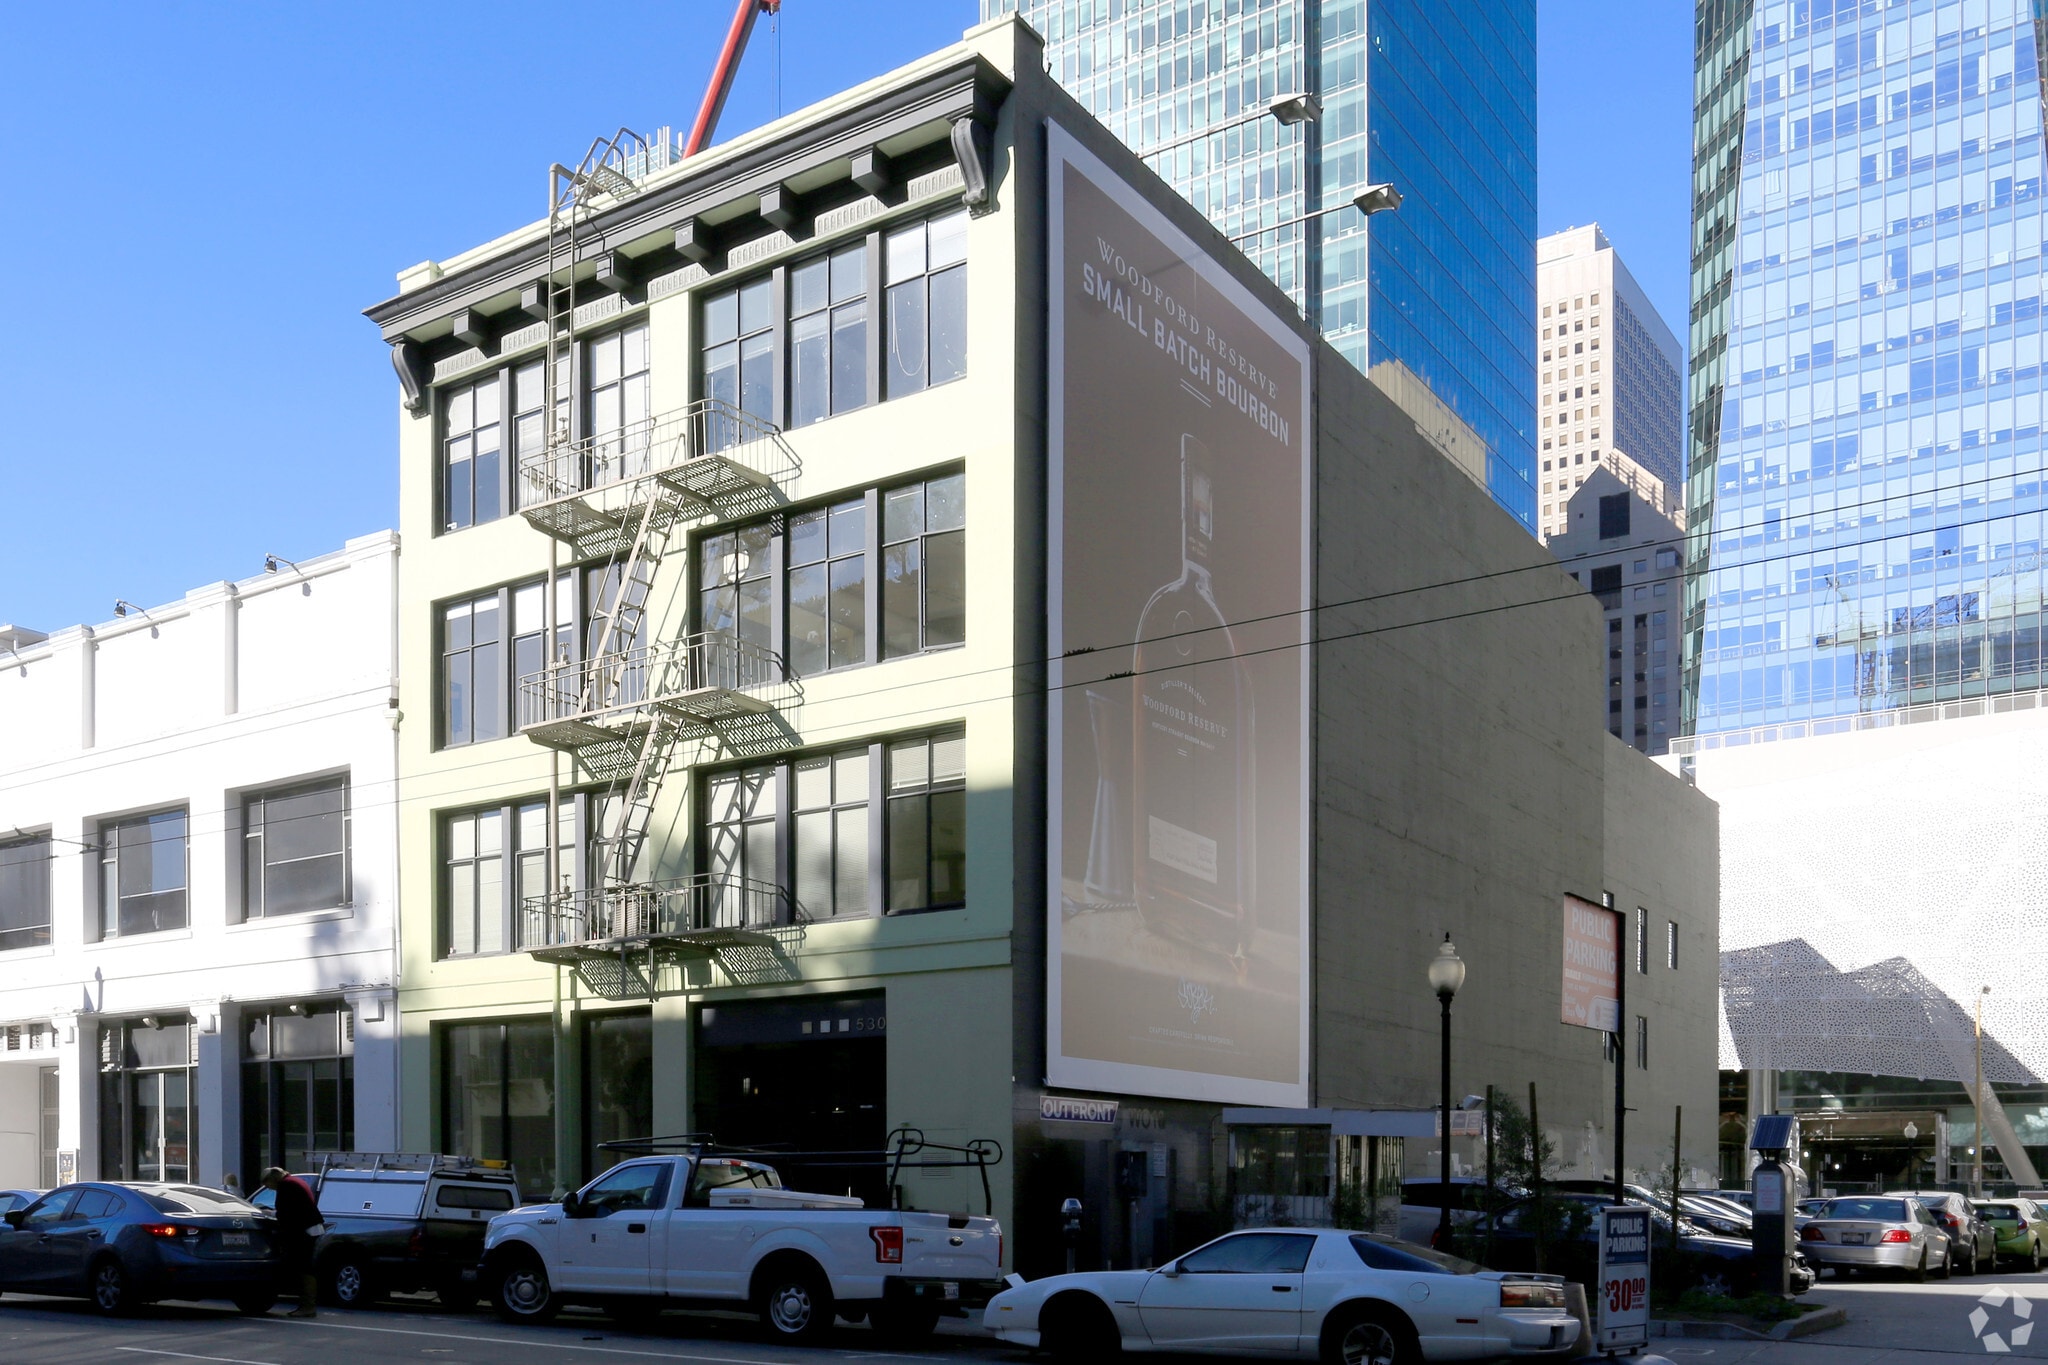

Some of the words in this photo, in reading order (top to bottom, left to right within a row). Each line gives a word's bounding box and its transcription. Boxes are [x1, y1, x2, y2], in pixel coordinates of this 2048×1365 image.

[1097, 236, 1200, 335] WOODFORD
[1206, 325, 1278, 400] RESERVE
[1083, 262, 1148, 337] SMALL
[1154, 317, 1211, 386] BATCH
[1216, 366, 1289, 446] BOURBON
[1142, 693, 1186, 721] WOODFORD
[1187, 711, 1227, 738] RESERVE
[1571, 906, 1612, 943] PUBLIC
[1565, 936, 1617, 975] PARKING
[856, 1017, 886, 1031] 530
[1042, 1100, 1115, 1121] OUTFRONT
[1606, 1236, 1646, 1253] PARKING
[1610, 1218, 1643, 1234] PUBLIC
